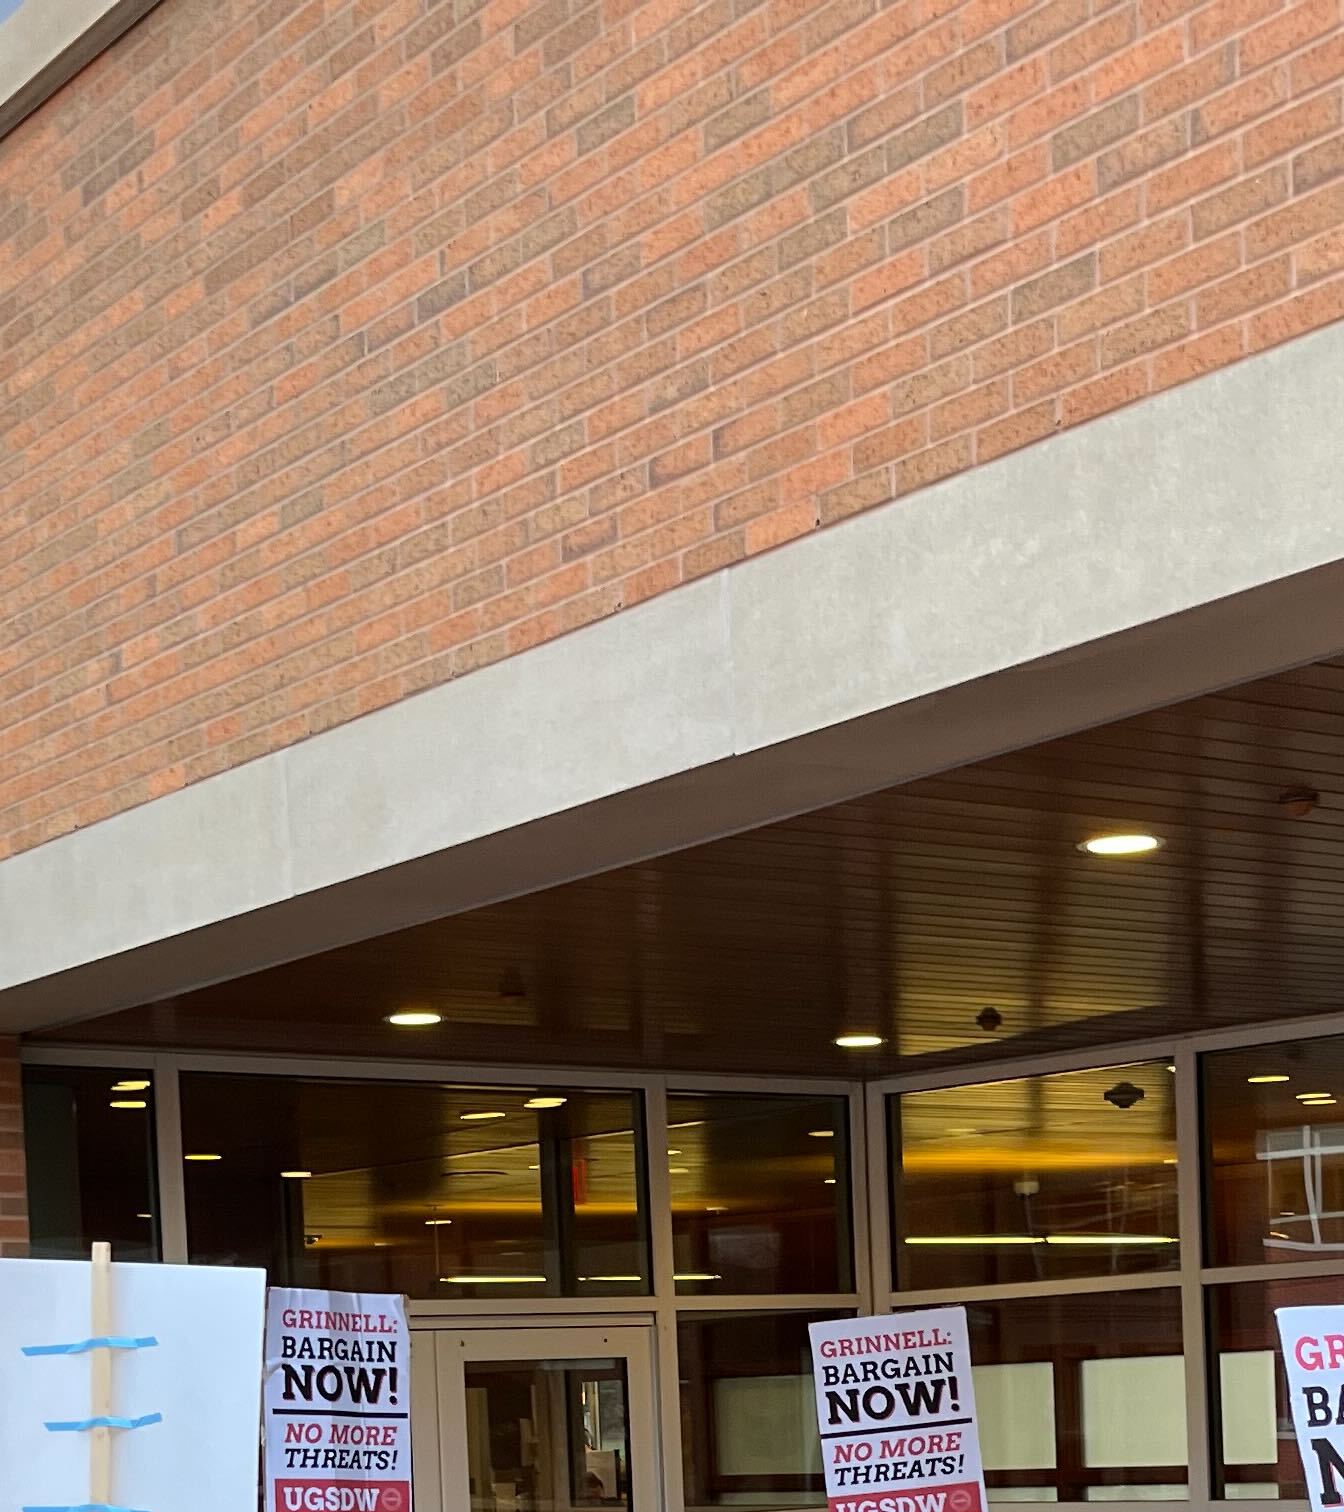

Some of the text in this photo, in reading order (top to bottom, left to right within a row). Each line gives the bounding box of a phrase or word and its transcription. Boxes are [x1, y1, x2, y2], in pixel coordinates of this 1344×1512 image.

[282, 1309, 397, 1333] GRINNELL:
[281, 1335, 397, 1363] BARGAIN
[820, 1328, 952, 1359] GRINNELL:
[822, 1351, 954, 1386] BARGAIN
[282, 1364, 398, 1405] NOW!
[825, 1376, 960, 1425] NOW!
[284, 1423, 397, 1446] NO MORE
[833, 1432, 962, 1464] NO MORE
[285, 1448, 398, 1470] THREATS!
[834, 1454, 965, 1487] THREATS!
[283, 1486, 379, 1512] UGSDW
